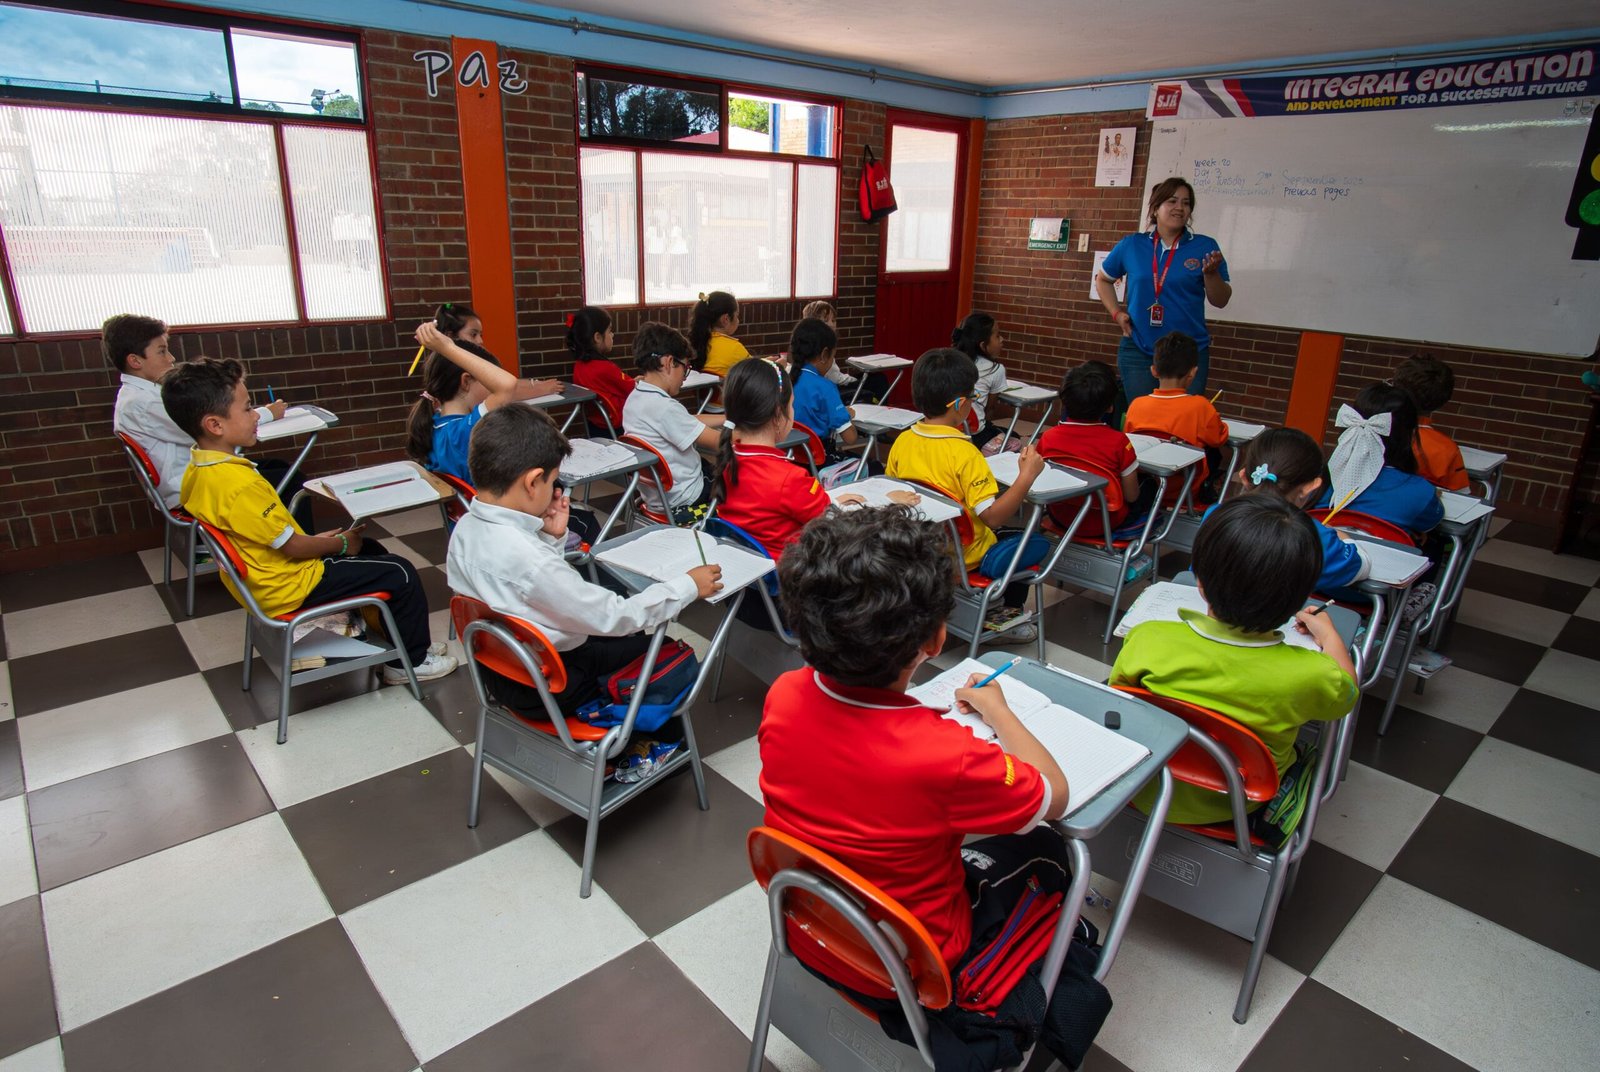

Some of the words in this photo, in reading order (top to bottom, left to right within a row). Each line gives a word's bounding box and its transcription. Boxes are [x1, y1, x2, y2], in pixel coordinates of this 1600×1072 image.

[1284, 71, 1411, 100] INTEGRAL
[1415, 50, 1594, 92] EDUCATION
[1286, 101, 1310, 112] AND
[1310, 96, 1398, 111] DEVELOPMENT
[1401, 93, 1427, 105] FOR
[1428, 92, 1438, 103] A
[1441, 85, 1525, 102] SUCCESSFUL
[1526, 80, 1588, 96] FUTURE
